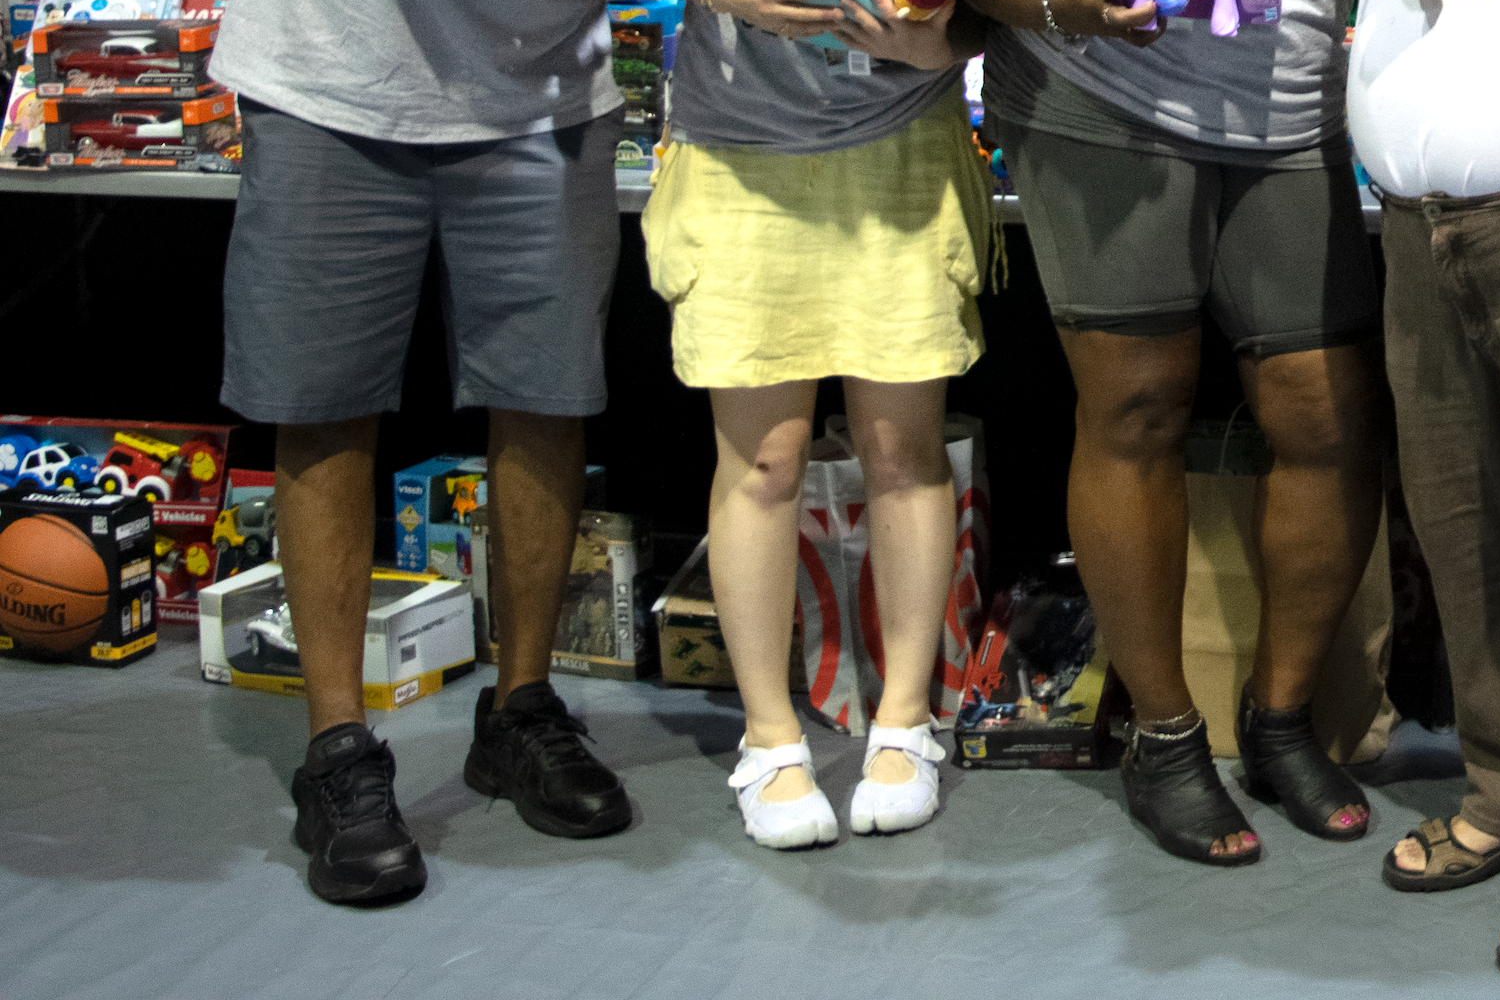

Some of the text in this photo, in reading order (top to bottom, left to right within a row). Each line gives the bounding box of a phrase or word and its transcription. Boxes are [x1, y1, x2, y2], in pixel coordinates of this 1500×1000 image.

[161, 511, 206, 522] Vehicles
[3, 595, 65, 627] LDING
[159, 608, 199, 620] Vehicle
